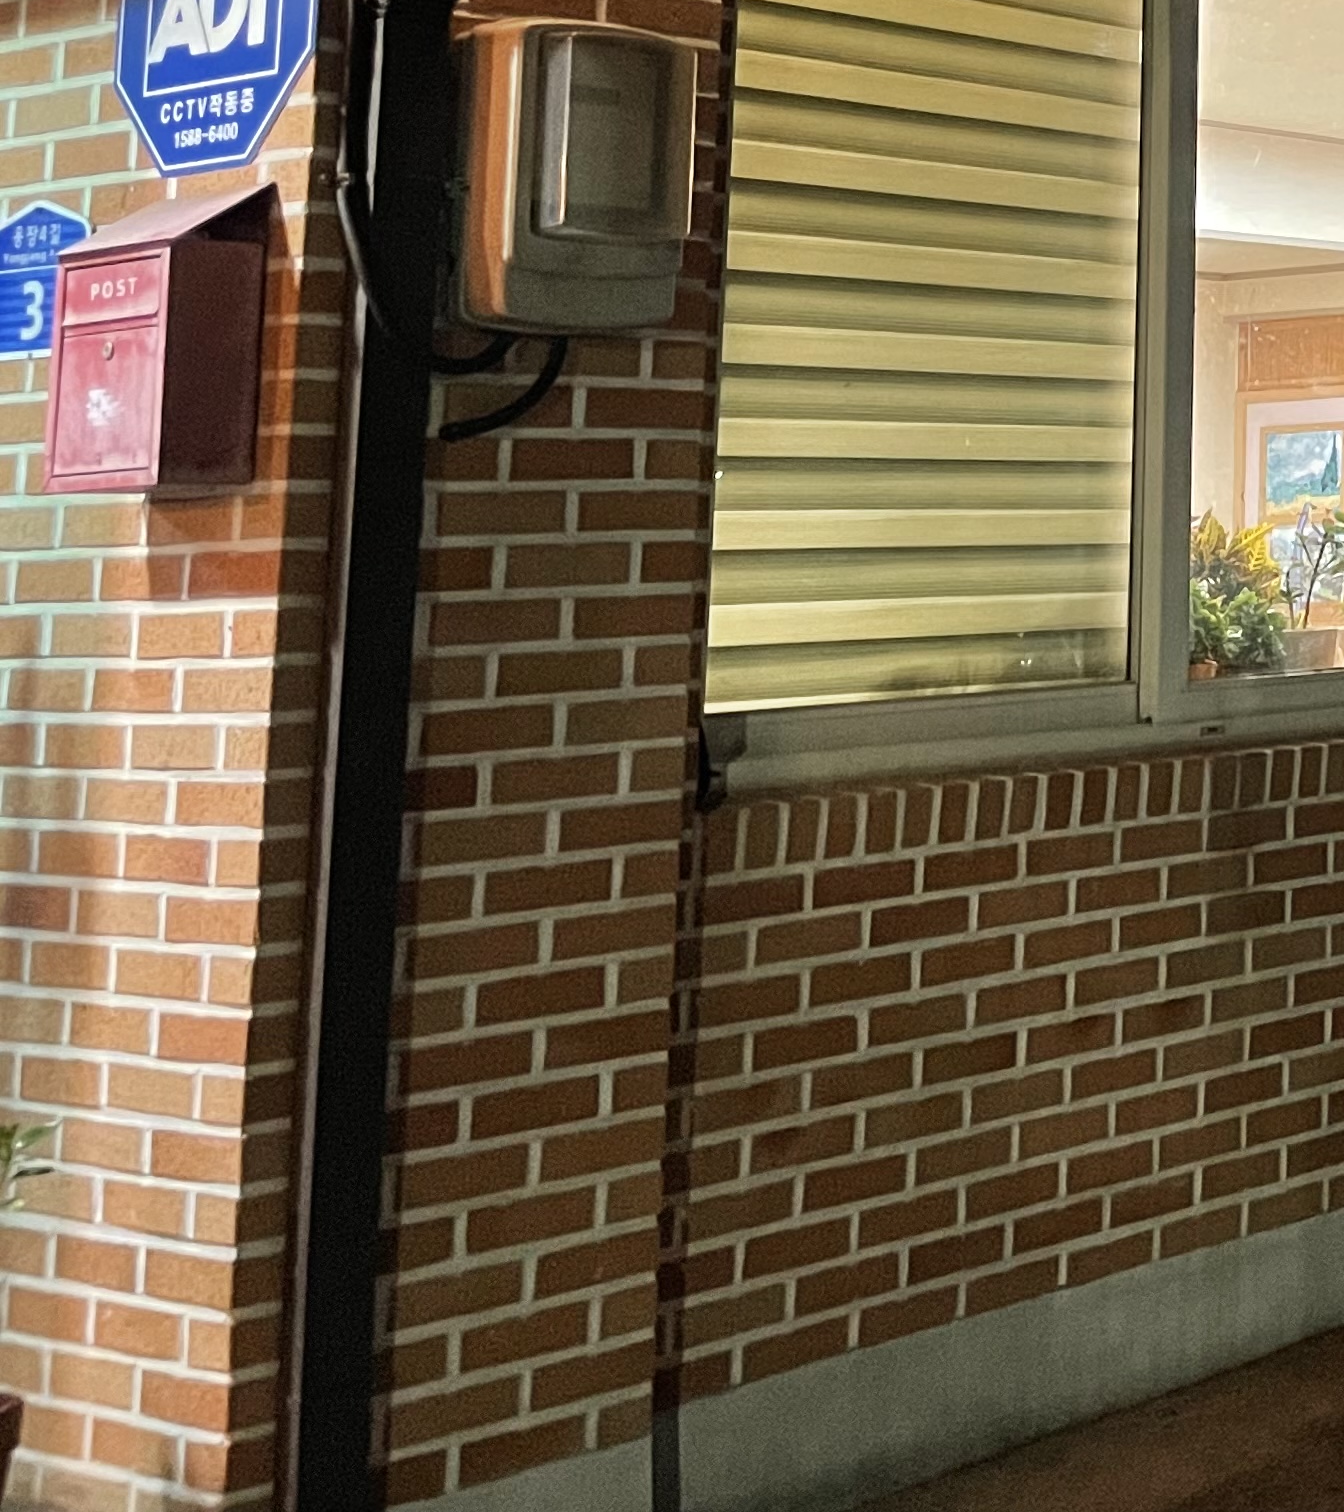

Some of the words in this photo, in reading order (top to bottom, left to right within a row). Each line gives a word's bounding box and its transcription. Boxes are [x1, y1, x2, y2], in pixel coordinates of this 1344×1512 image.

[174, 121, 239, 149] 1588-6400
[90, 276, 138, 301] POST
[20, 280, 45, 340] 3
